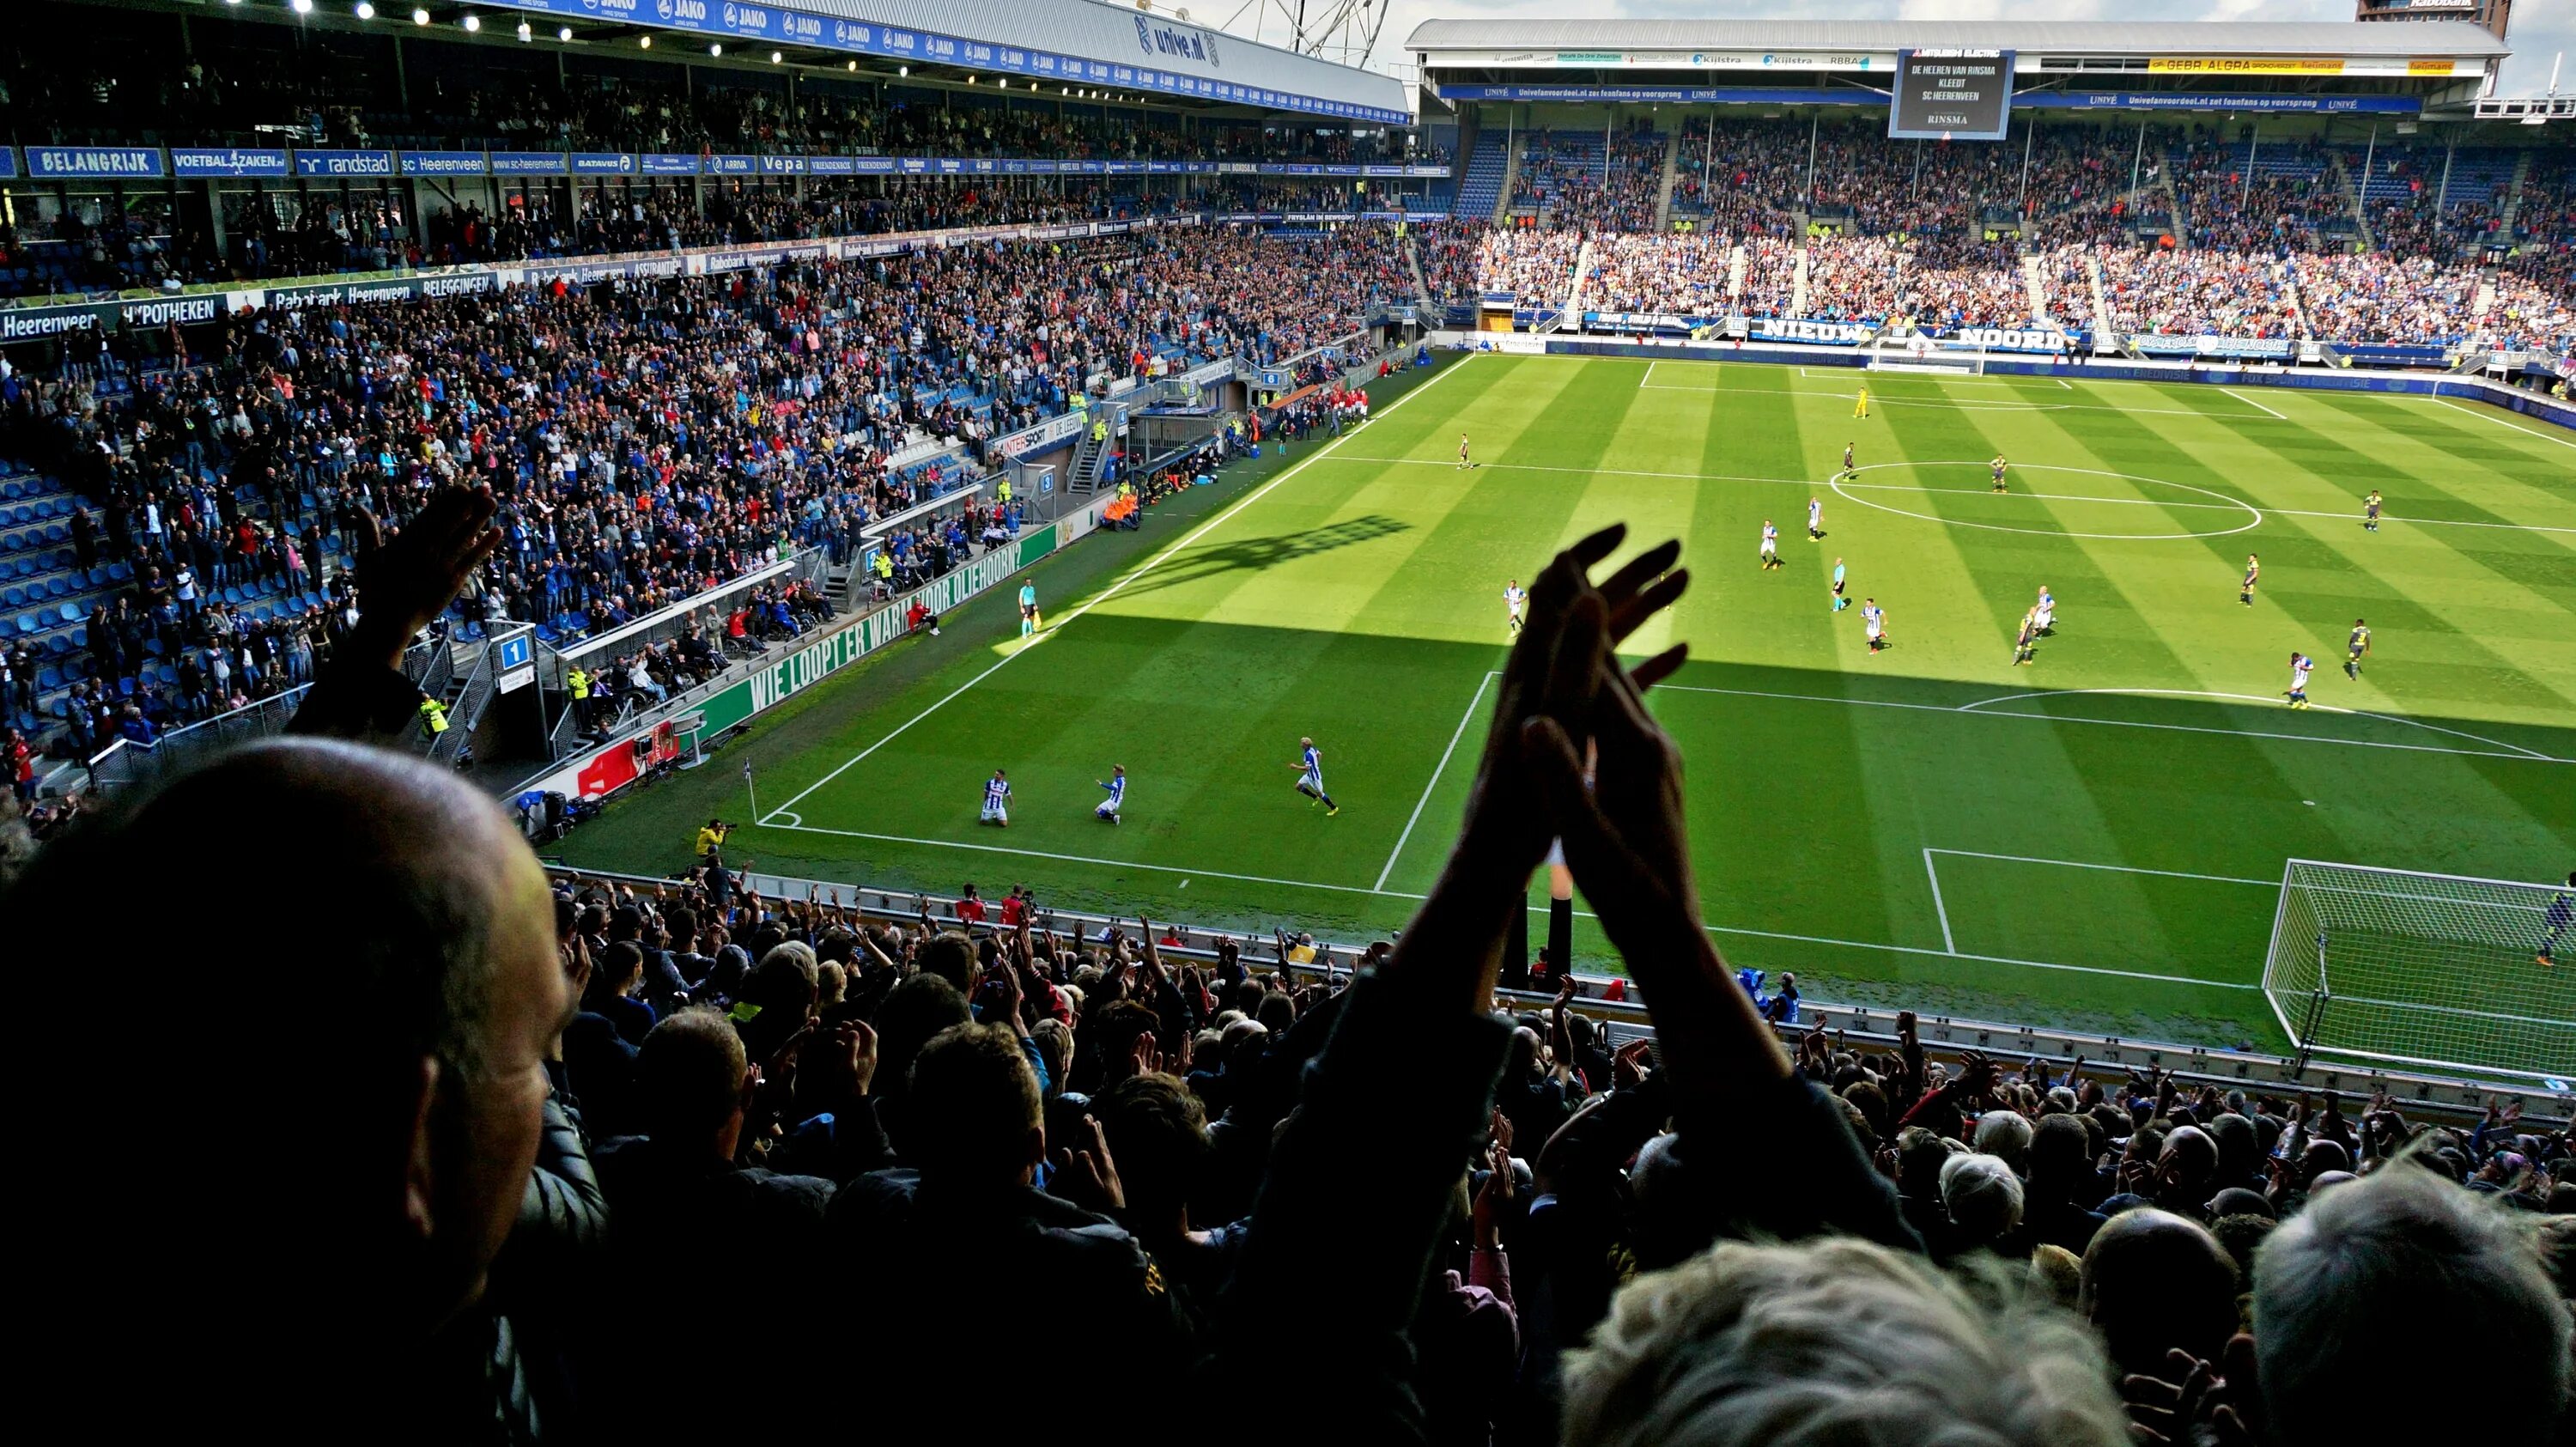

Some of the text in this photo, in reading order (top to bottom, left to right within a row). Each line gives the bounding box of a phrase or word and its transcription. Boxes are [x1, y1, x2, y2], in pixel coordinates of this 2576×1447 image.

[675, 0, 706, 20] JAKO
[739, 9, 767, 28] JAKO
[796, 17, 821, 36] JAKO
[847, 25, 870, 43] JAKO
[893, 33, 914, 50] JAKO
[935, 40, 954, 56] JAKO
[973, 46, 991, 61] JAKO
[1008, 52, 1024, 66] JAKO
[1921, 49, 2001, 58] MITSUBISHI ELECTRIC
[1039, 56, 1054, 70] JAKO
[1704, 56, 1741, 65] Kijlstra
[1774, 57, 1813, 66] Kijlstra
[1831, 57, 1858, 65] RBBA
[2166, 60, 2204, 70] GEBR.
[2208, 60, 2250, 70] ALGRA
[2301, 61, 2342, 71] heijmans
[2410, 61, 2452, 71] heijmans
[1068, 61, 1082, 74] JAKO
[1095, 65, 1108, 78] JAKO
[1911, 65, 1996, 76] DE HEEREN VAN RINSMA
[1120, 68, 1132, 81] JAKO
[1142, 71, 1154, 83] JAKO
[1938, 78, 1966, 88] KLEEDT
[1485, 87, 1509, 97] UNIVÉ
[1642, 91, 1682, 100] voorsprong
[1692, 90, 1717, 100] UNIVÉ
[1922, 91, 1980, 100] SC HEERENVEEN
[2089, 94, 2117, 105] UNIVÉ
[2271, 99, 2318, 108] voorsprong
[2328, 99, 2358, 109] UNIVÉ
[1928, 115, 1968, 125] RINSMA
[43, 152, 149, 172] BELANGRIJK
[328, 153, 388, 173] randstad
[402, 156, 484, 171] sc Heerenveen
[492, 157, 565, 170] www.sc-heerenveen.nl
[724, 159, 748, 170] ARRIVA
[764, 156, 804, 172] Vepa
[811, 160, 852, 170] VRIENDENBOX
[710, 254, 745, 270] Rabobank
[531, 268, 578, 287] Rbobank
[423, 276, 489, 297] BELEGGINGEN
[348, 285, 410, 304] Heerenveen
[3, 313, 98, 337] Heerenveen
[1763, 318, 1866, 342] NIEUW
[1959, 327, 2065, 350] NOORD
[1267, 374, 1273, 384] 6
[2242, 374, 2263, 384] FOX
[2265, 374, 2309, 386] SPORTS
[1120, 412, 1126, 423] 4
[1004, 429, 1046, 454] INTERSPORT
[1055, 423, 1063, 436] DE
[1044, 477, 1050, 489] 3
[869, 556, 876, 568] 2
[750, 666, 787, 712] WIE
[788, 632, 840, 692] LOOPT
[845, 626, 865, 664] ER
[867, 599, 911, 653] WARM
[952, 541, 1022, 607] OLIEHOORN?
[2357, 632, 2366, 642] 3
[510, 642, 520, 662] 1
